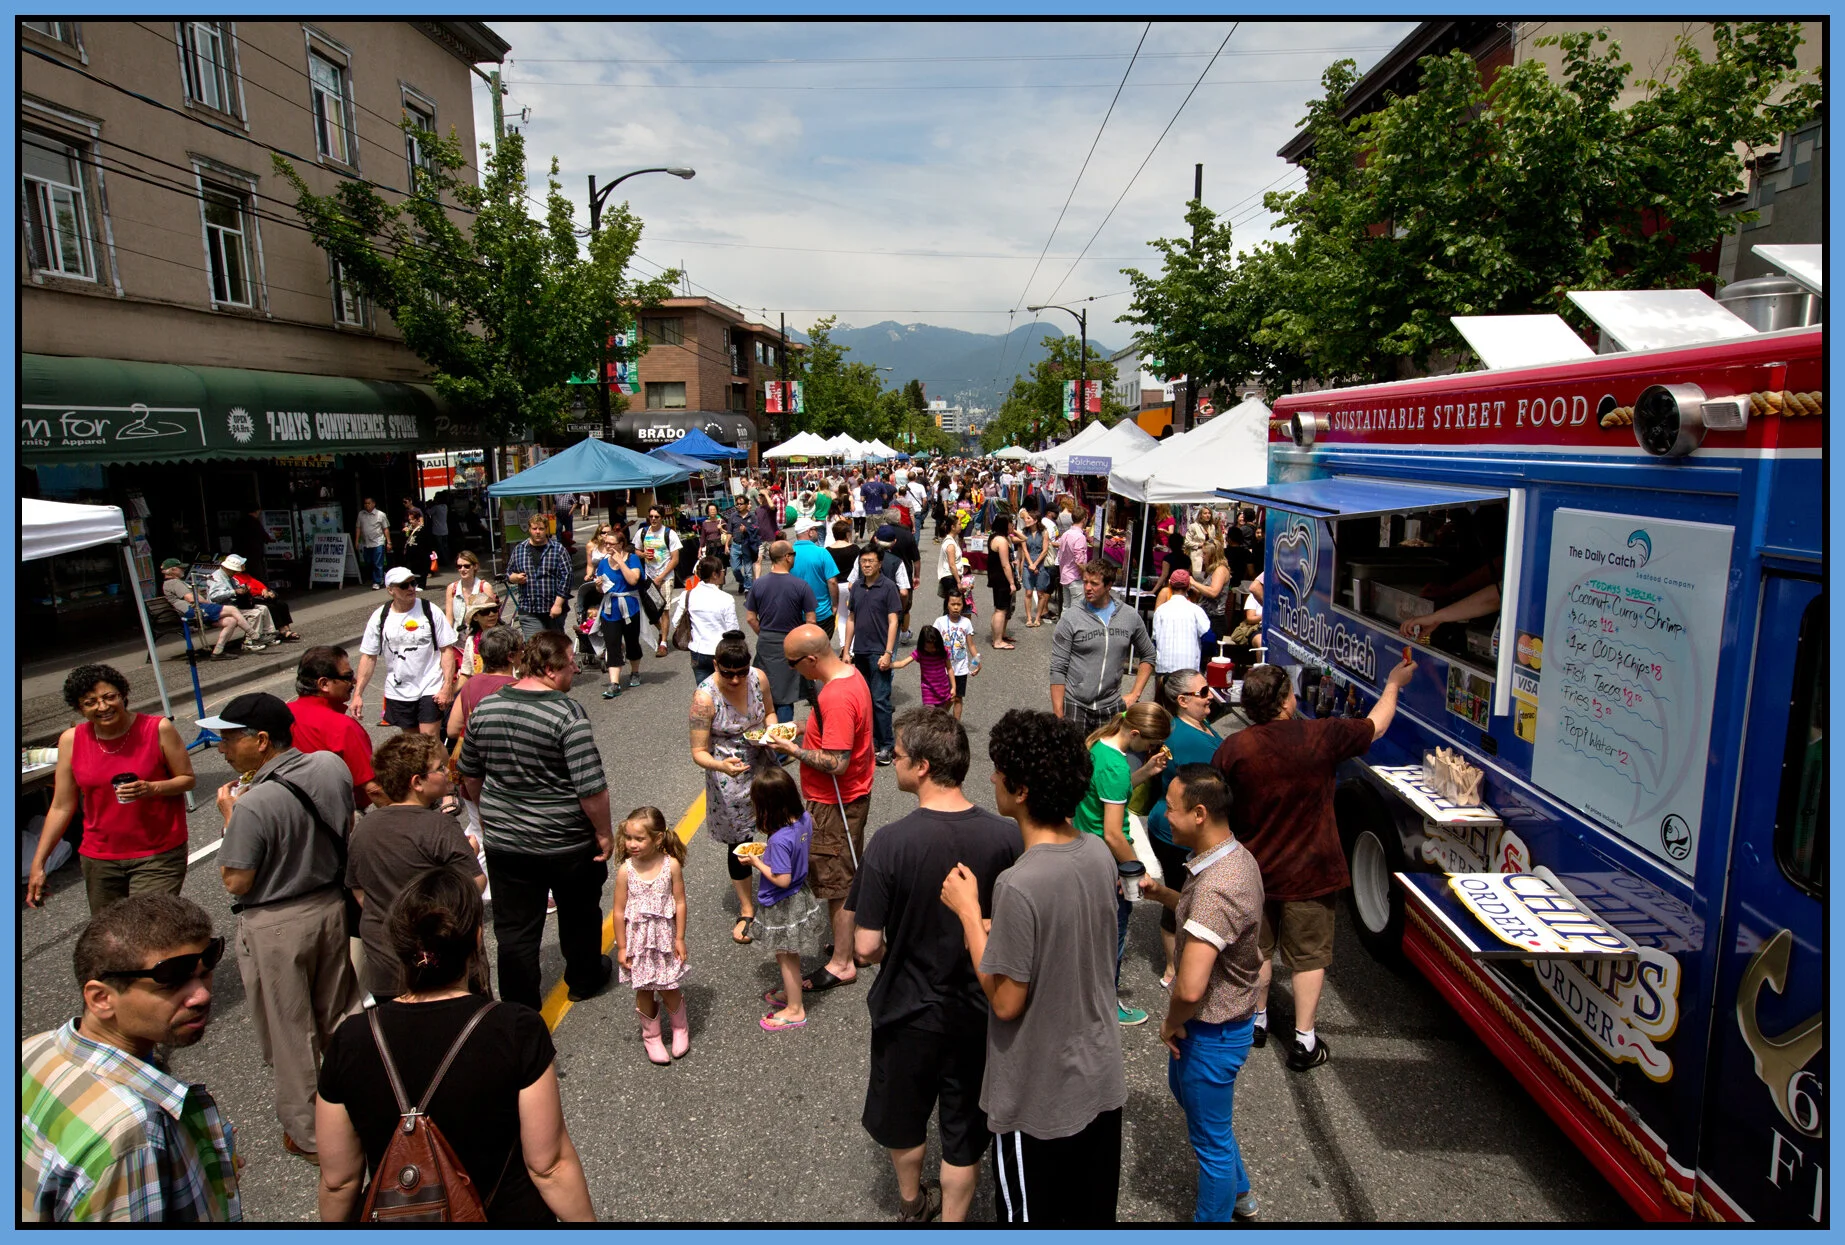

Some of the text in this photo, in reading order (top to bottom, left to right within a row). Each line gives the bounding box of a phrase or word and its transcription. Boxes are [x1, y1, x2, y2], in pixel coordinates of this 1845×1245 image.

[59, 411, 111, 437] for
[266, 411, 419, 441] 7-DAYS CONVENIENCE STORE
[1335, 396, 1588, 430] SUSTAINABLE STREET FOOD
[61, 438, 106, 447] Apparel
[638, 428, 686, 439] BRADO
[1074, 458, 1109, 468] alchemy
[1569, 546, 1636, 568] The Daily Catch
[1590, 580, 1621, 594] TODAYS
[1636, 571, 1695, 590] Seafood Company
[1571, 584, 1683, 640] Coconut Curry Shrimp
[1279, 594, 1299, 636] The
[1300, 605, 1333, 661] Daily
[1332, 623, 1376, 681] Catch
[1518, 676, 1538, 696] VISA
[1565, 663, 1586, 683] Fish
[1594, 673, 1622, 702] Tacos
[1563, 685, 1590, 712] Fries
[1460, 878, 1542, 940] ORDER
[1500, 873, 1638, 952] CHIP
[1536, 960, 1614, 1048] ORDER
